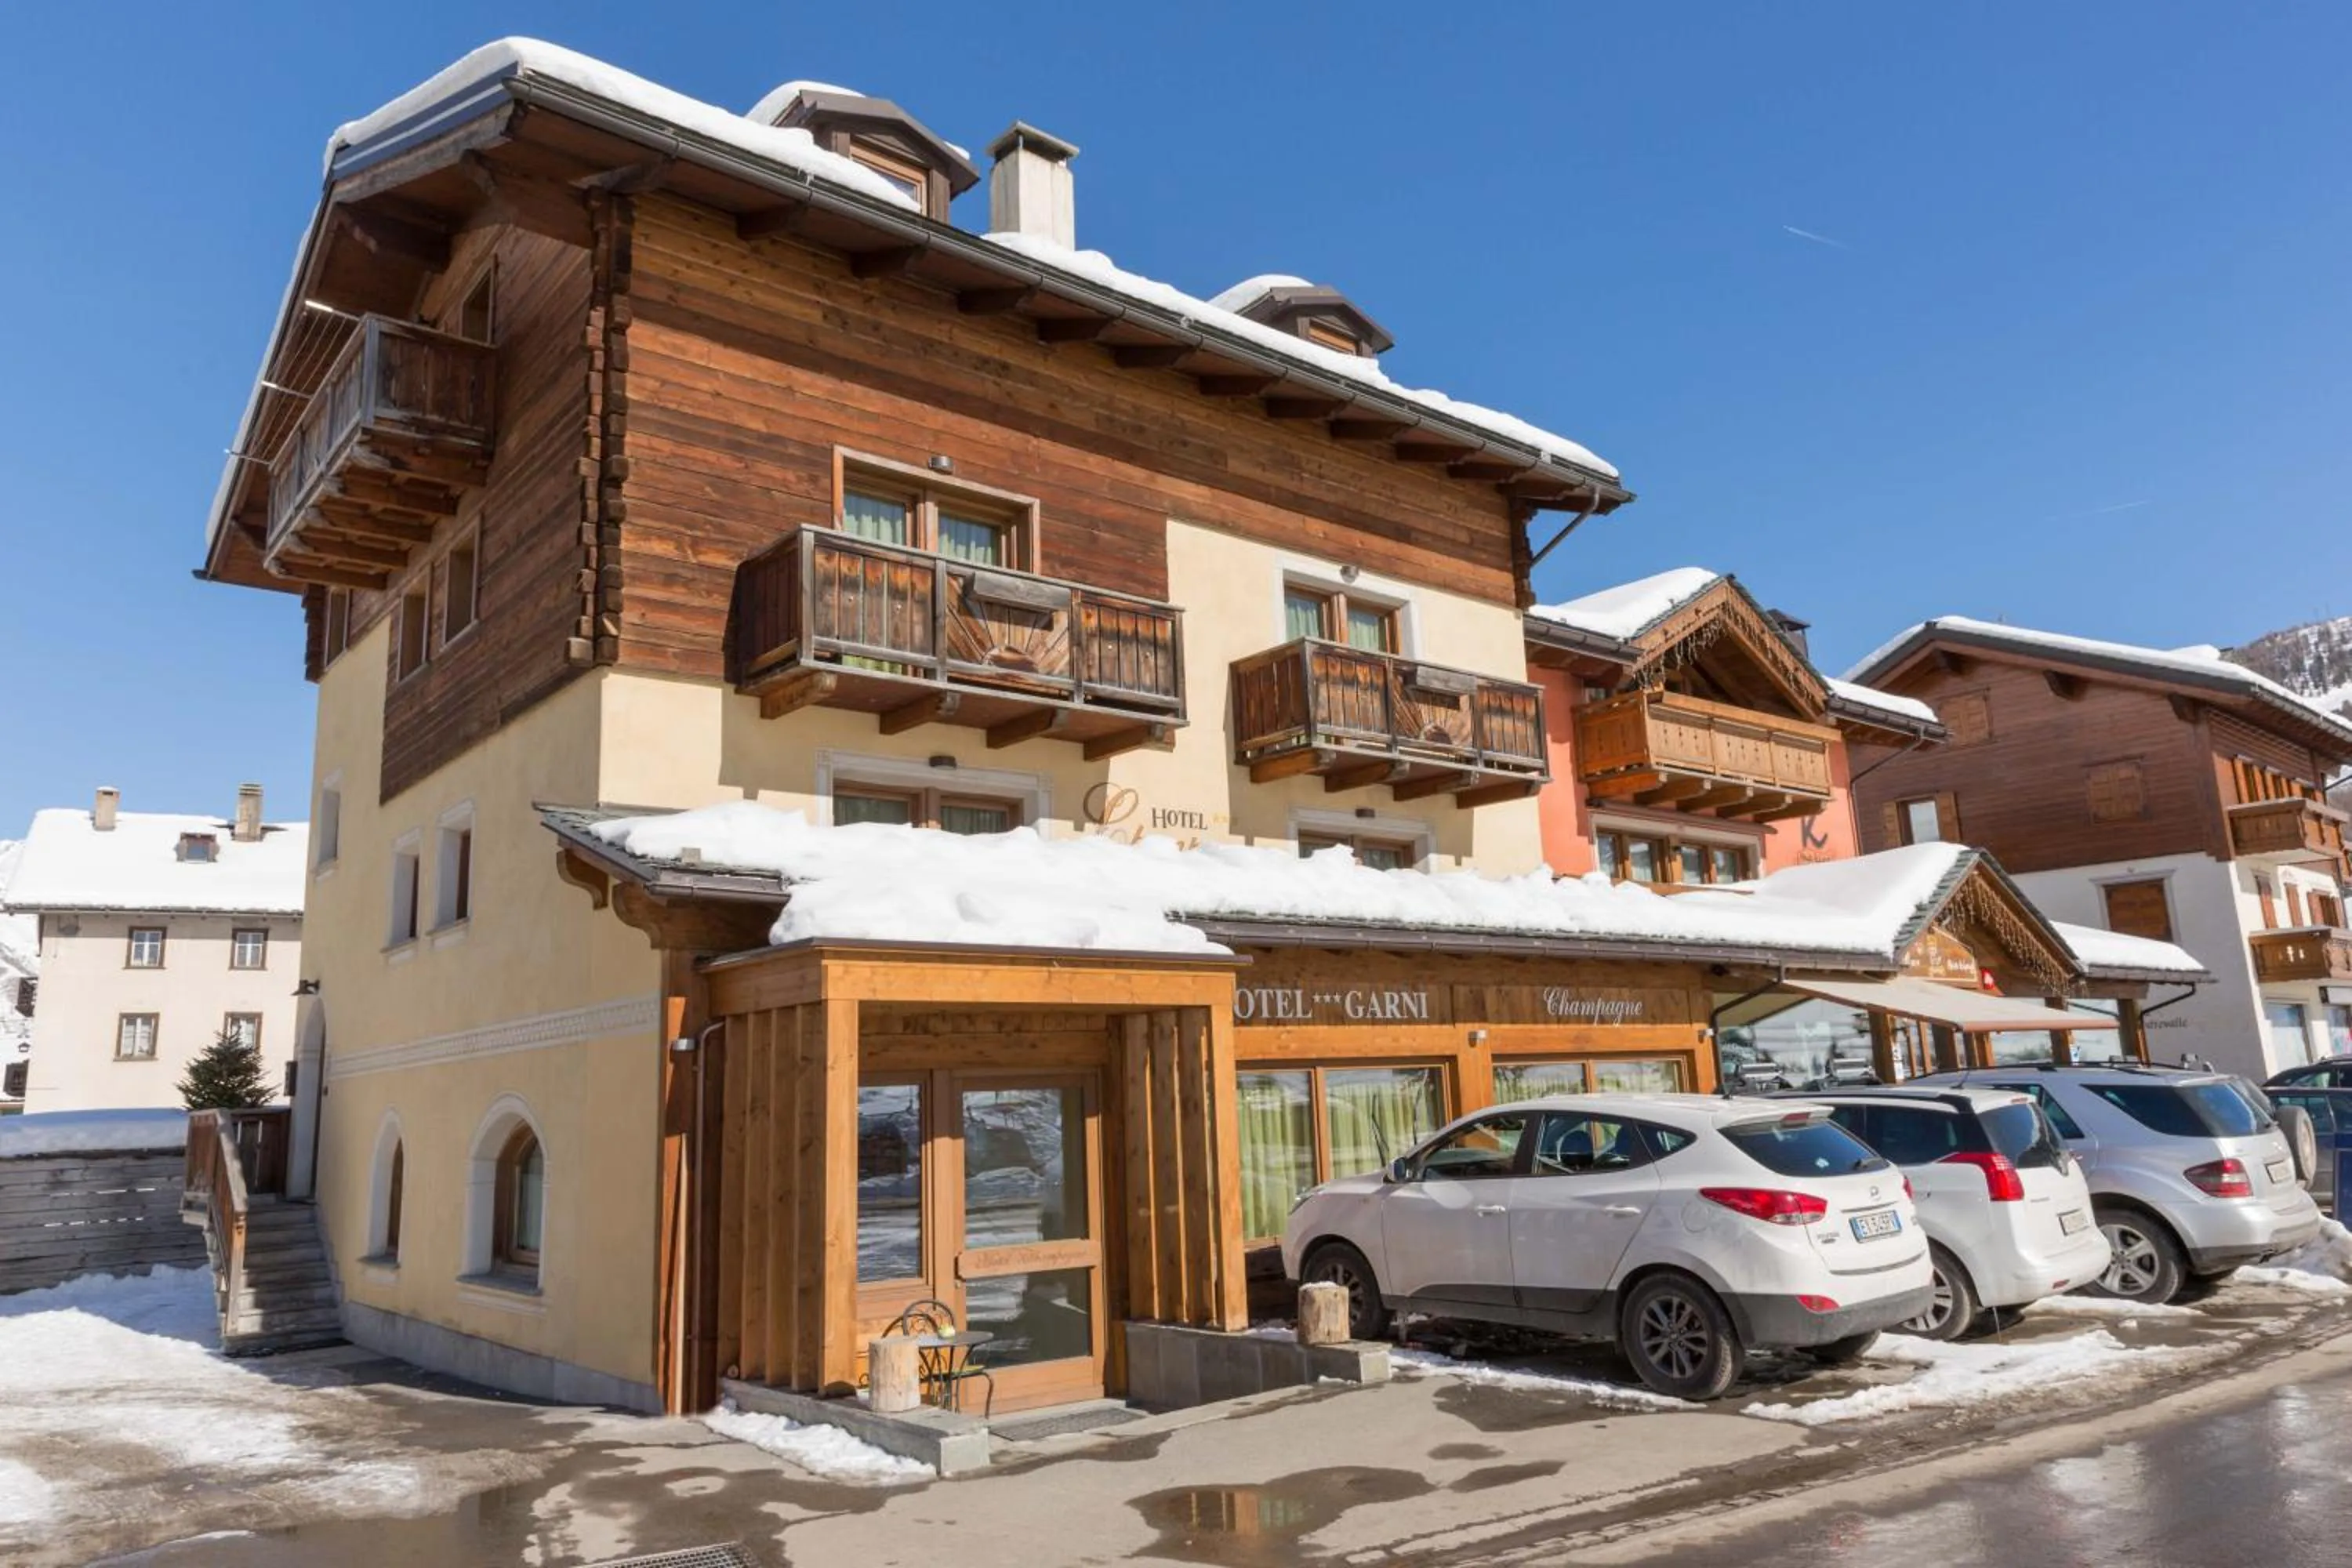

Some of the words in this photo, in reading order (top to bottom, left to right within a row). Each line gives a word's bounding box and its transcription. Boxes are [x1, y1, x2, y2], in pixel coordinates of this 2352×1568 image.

[1151, 807, 1208, 830] HOTEL
[1234, 988, 1312, 1018] OTEL
[1345, 990, 1429, 1018] GARNI
[1543, 986, 1643, 1026] Champagne
